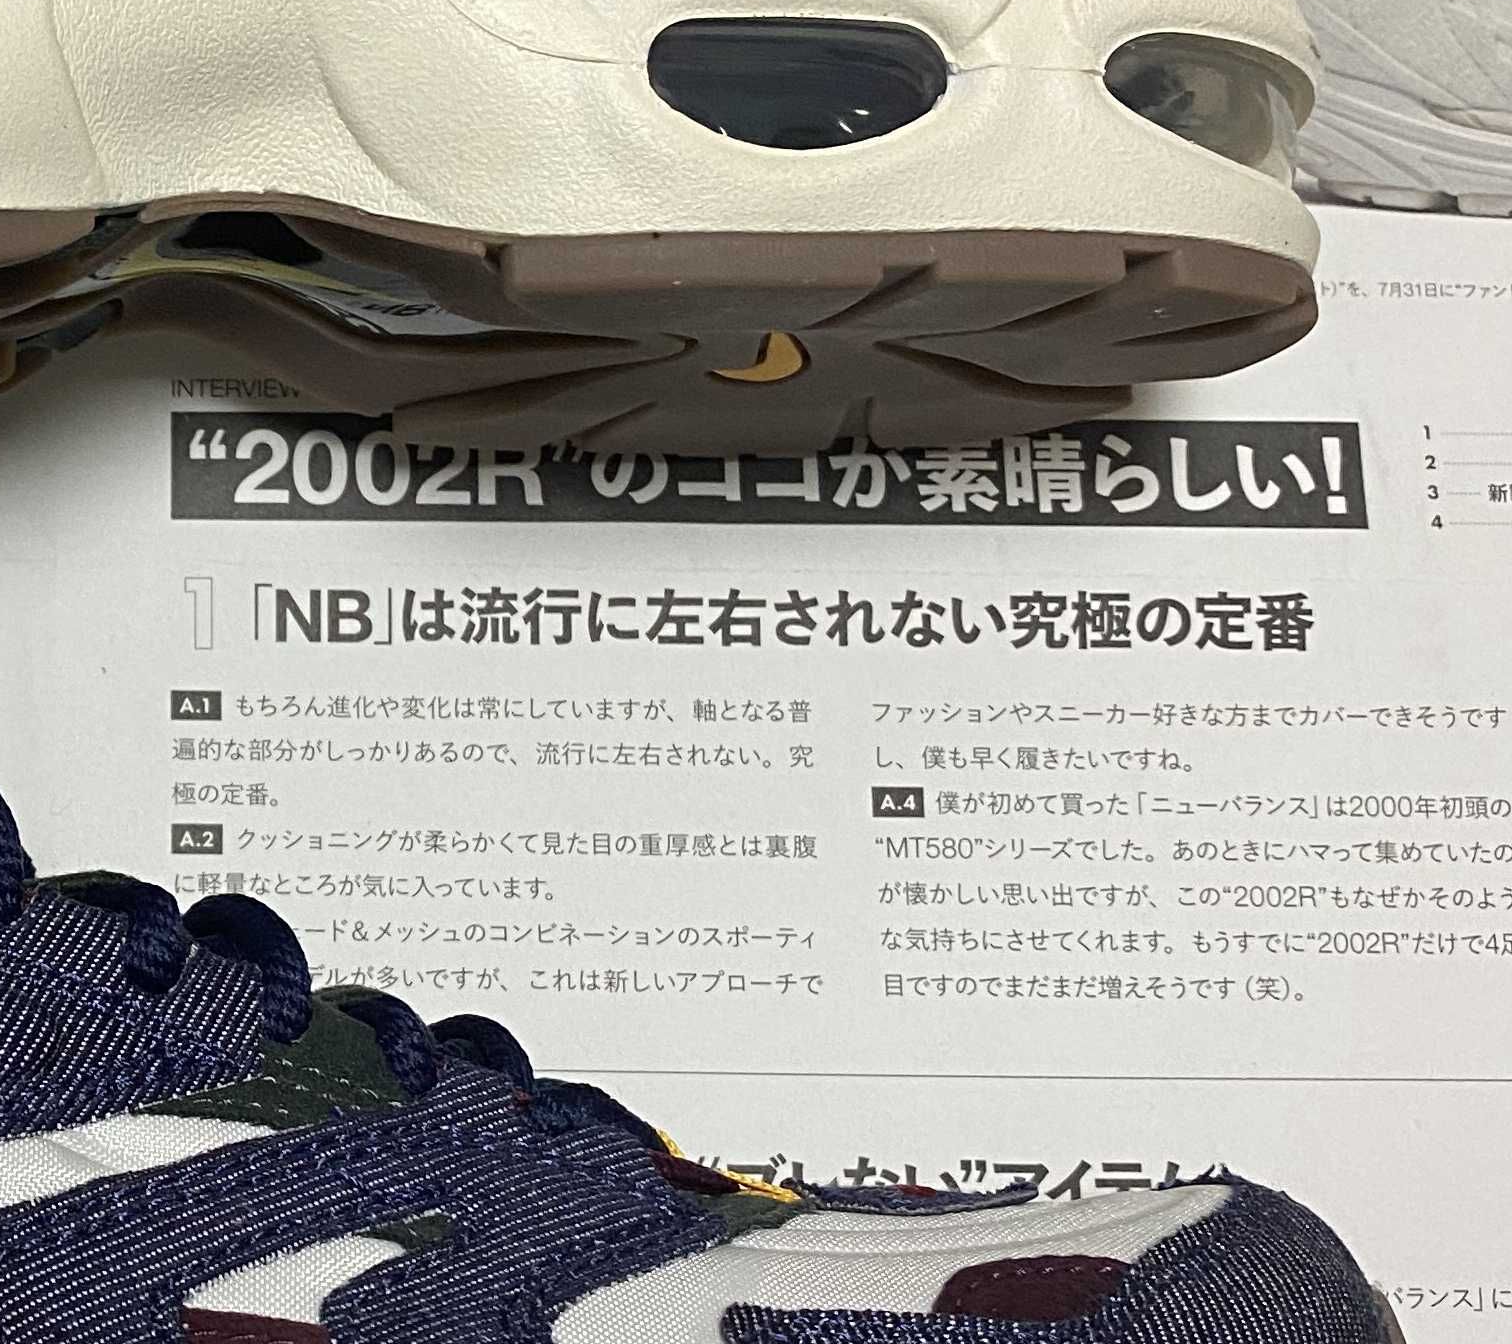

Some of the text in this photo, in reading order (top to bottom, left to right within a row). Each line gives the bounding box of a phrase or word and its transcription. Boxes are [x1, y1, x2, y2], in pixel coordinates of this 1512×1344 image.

[1424, 454, 1437, 470] 2
[1427, 484, 1440, 500] 3
[1430, 514, 1444, 530] 4
[177, 695, 214, 717] A.1
[171, 781, 281, 808] 極の定番。
[878, 792, 918, 814] A.4
[178, 829, 218, 851] A.2
[296, 918, 816, 950] ード&メッシュのコンビネーションのスポーティ
